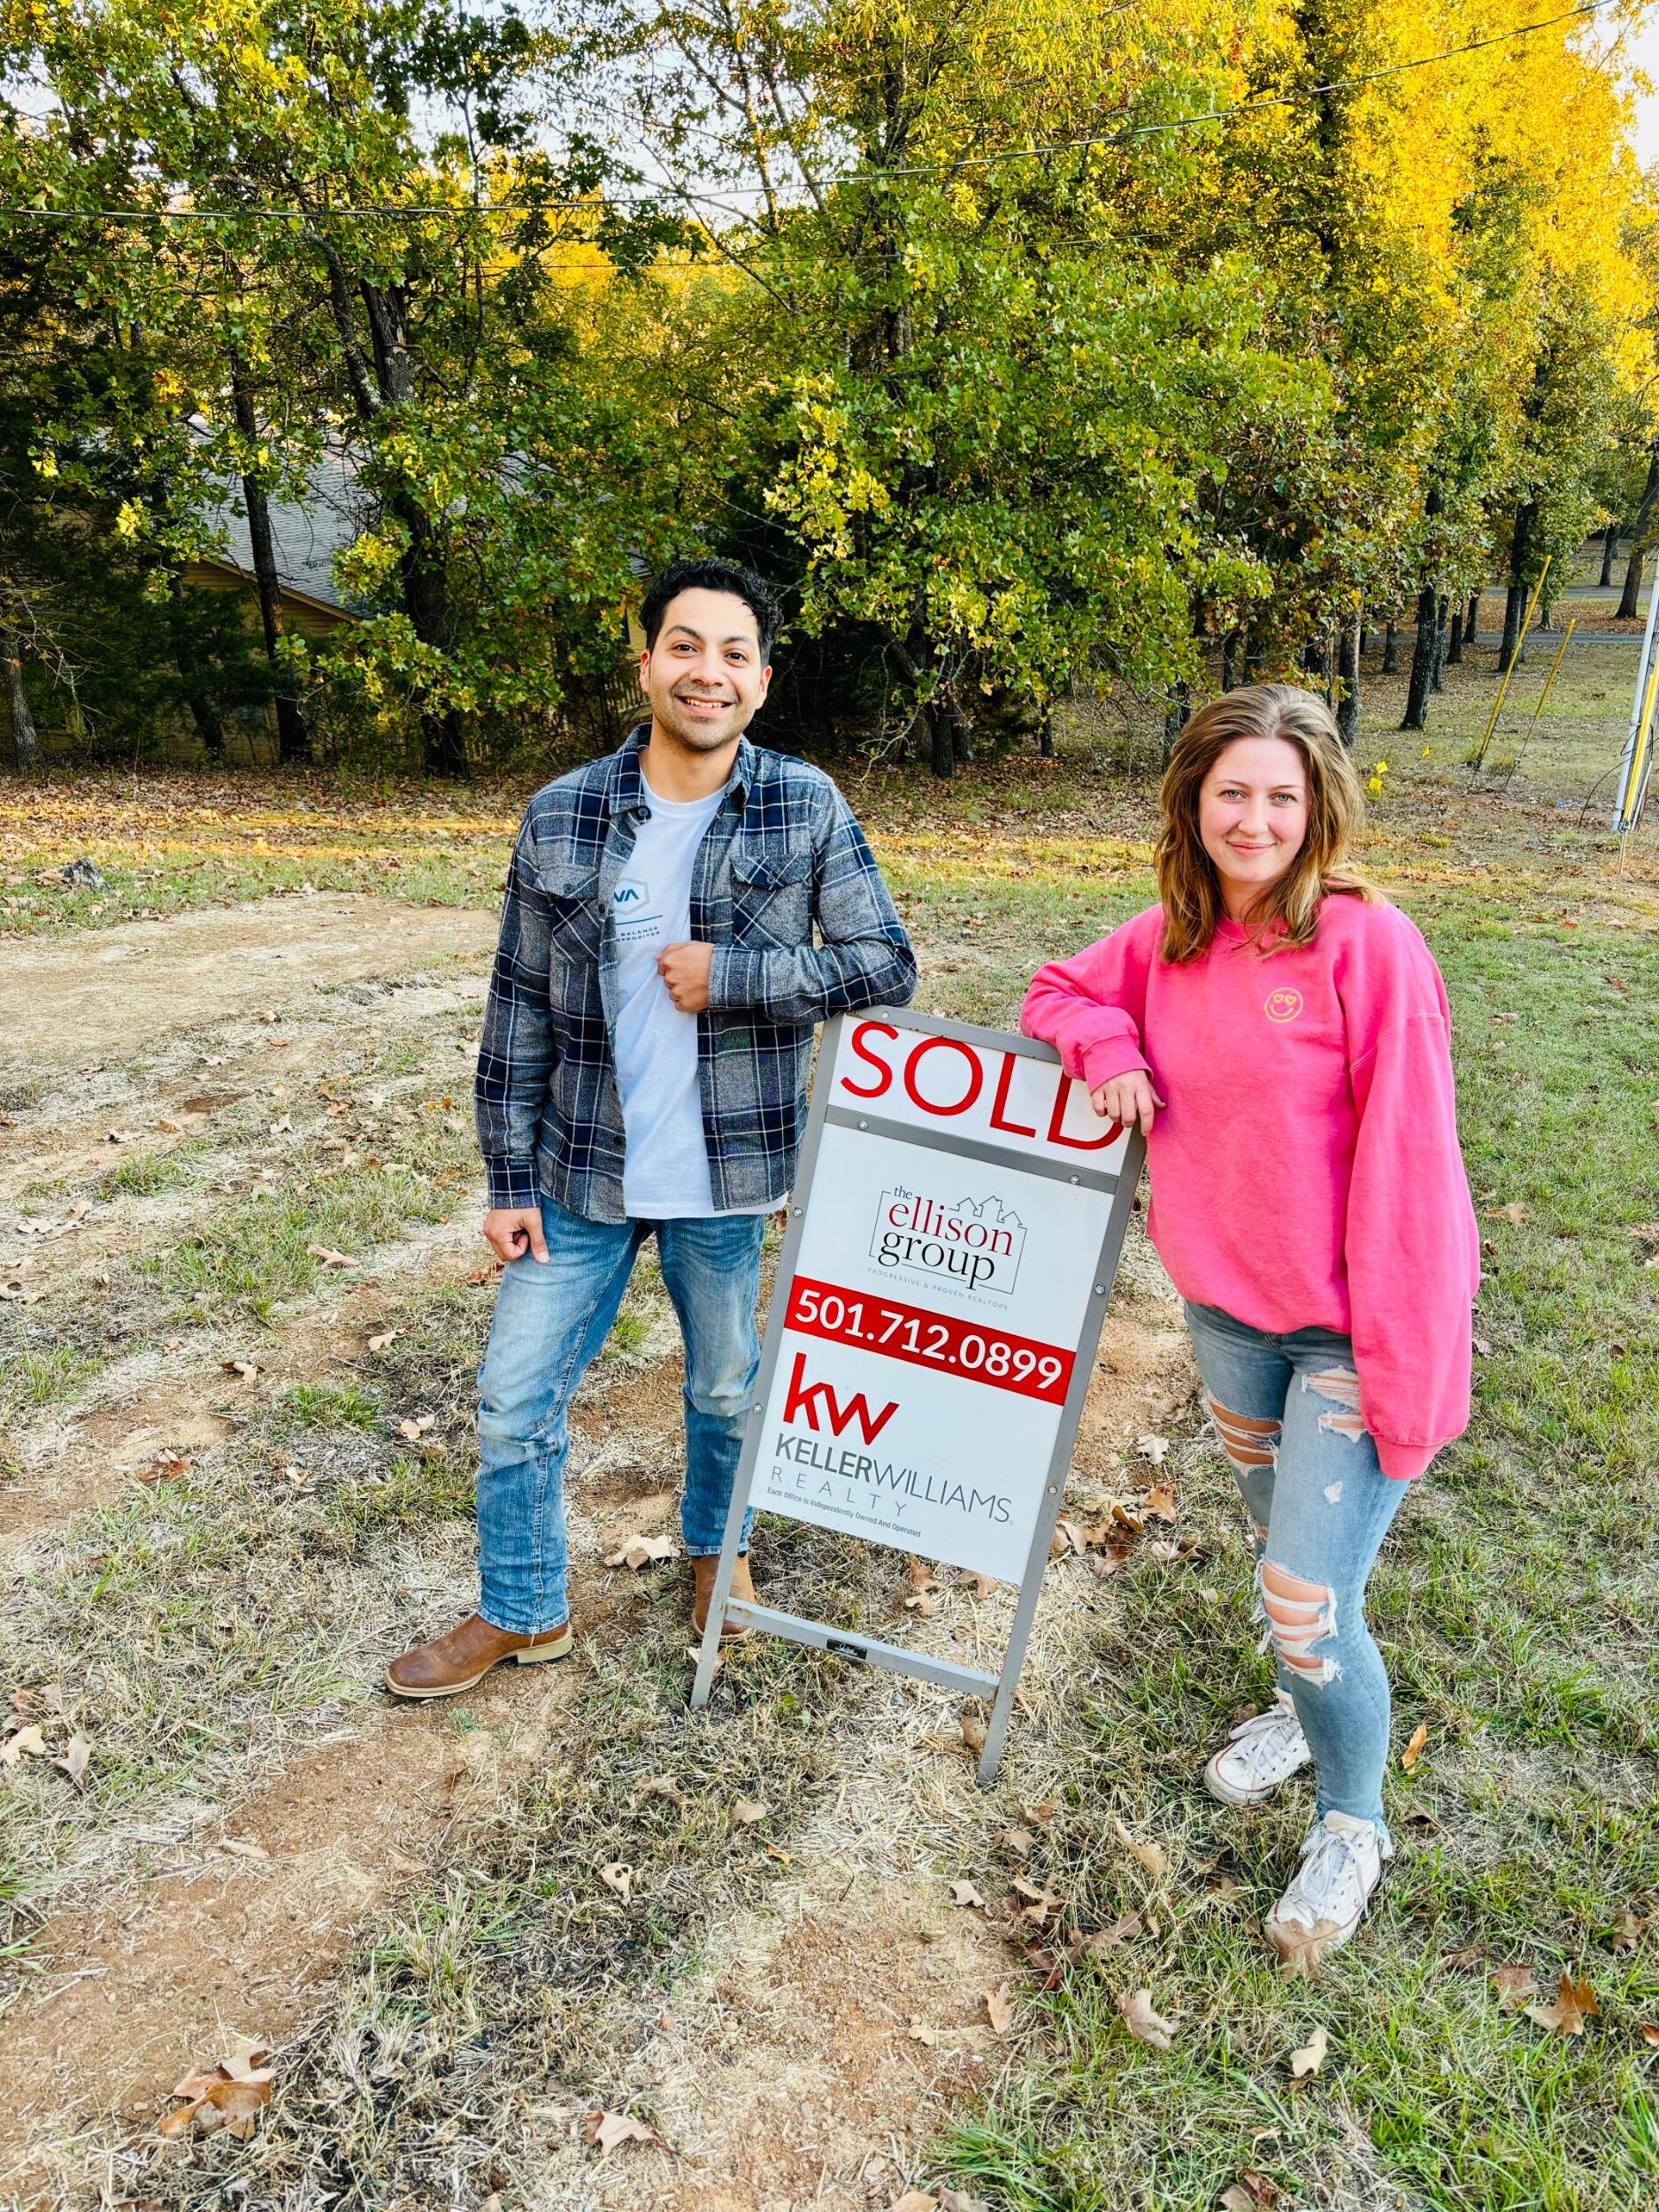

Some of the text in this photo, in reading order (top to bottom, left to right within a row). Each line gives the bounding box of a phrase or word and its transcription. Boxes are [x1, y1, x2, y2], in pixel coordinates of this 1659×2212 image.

[841, 1021, 1125, 1150] SOLD
[894, 1186, 913, 1200] the
[888, 1196, 1013, 1256] ellison
[867, 1267, 920, 1288] PROGRESSIVE
[932, 1285, 964, 1299] PROVEN
[967, 1294, 1009, 1310] REALTORS
[878, 1232, 995, 1291] group
[795, 1288, 1063, 1391] 501.712.0899
[783, 1352, 900, 1446] kw
[767, 1486, 783, 1497] Each
[784, 1492, 803, 1502] Office
[810, 1500, 855, 1518] Independently
[855, 1512, 878, 1525] Owned
[878, 1518, 891, 1529] And
[892, 1523, 921, 1538] Operated
[771, 1465, 907, 1517] REALTY
